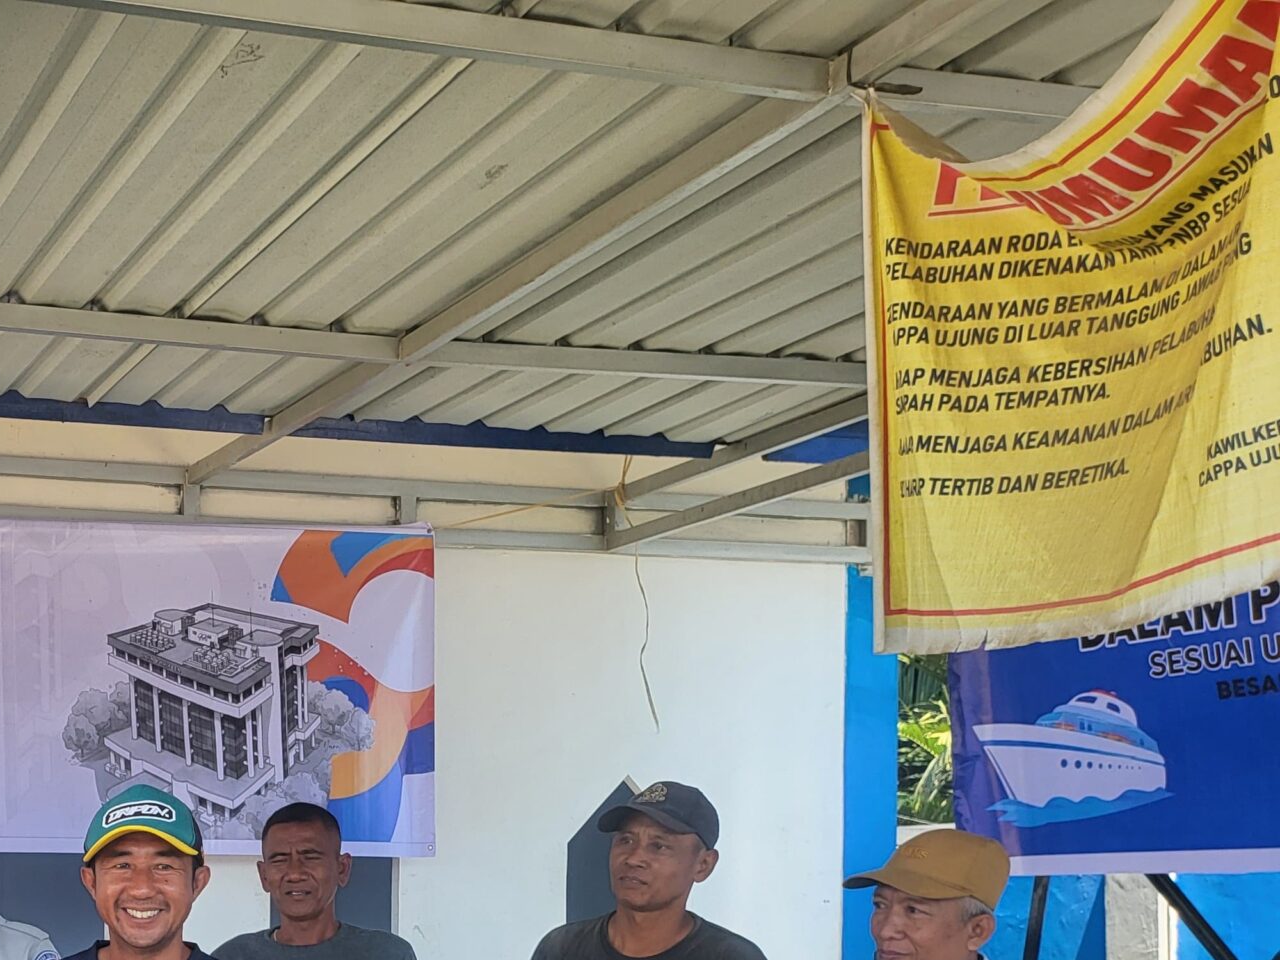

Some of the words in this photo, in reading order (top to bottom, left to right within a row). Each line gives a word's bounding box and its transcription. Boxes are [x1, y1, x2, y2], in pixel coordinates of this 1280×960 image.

[885, 237, 1002, 259] KENDARAAN
[1006, 230, 1062, 253] RODA
[886, 261, 994, 284] PELABUHAN
[998, 251, 1116, 279] DIKENAKAN
[997, 298, 1049, 319] YANG
[1053, 277, 1164, 315] BERMALAM
[935, 326, 999, 347] UJUNG
[1003, 324, 1024, 345] DI
[1026, 318, 1081, 341] LUAR
[1086, 291, 1180, 335] TANGGUNG
[928, 367, 1020, 388] MENJAGA
[1026, 345, 1149, 384] KEBERSIHAN
[937, 393, 989, 413] PADA
[995, 382, 1111, 411] TEMPATNYA.
[915, 434, 1007, 454] MENJAGA
[1012, 416, 1122, 451] KEAMANAN
[1122, 396, 1174, 433] DALAM
[1206, 419, 1280, 460] KAWILKE
[928, 476, 994, 496] TERTIB
[997, 473, 1039, 494] DAN
[1040, 457, 1130, 490] BERETIKA.
[1199, 456, 1247, 487] CAPPA
[1149, 637, 1255, 679] SESUAI
[1216, 675, 1280, 701] BESA
